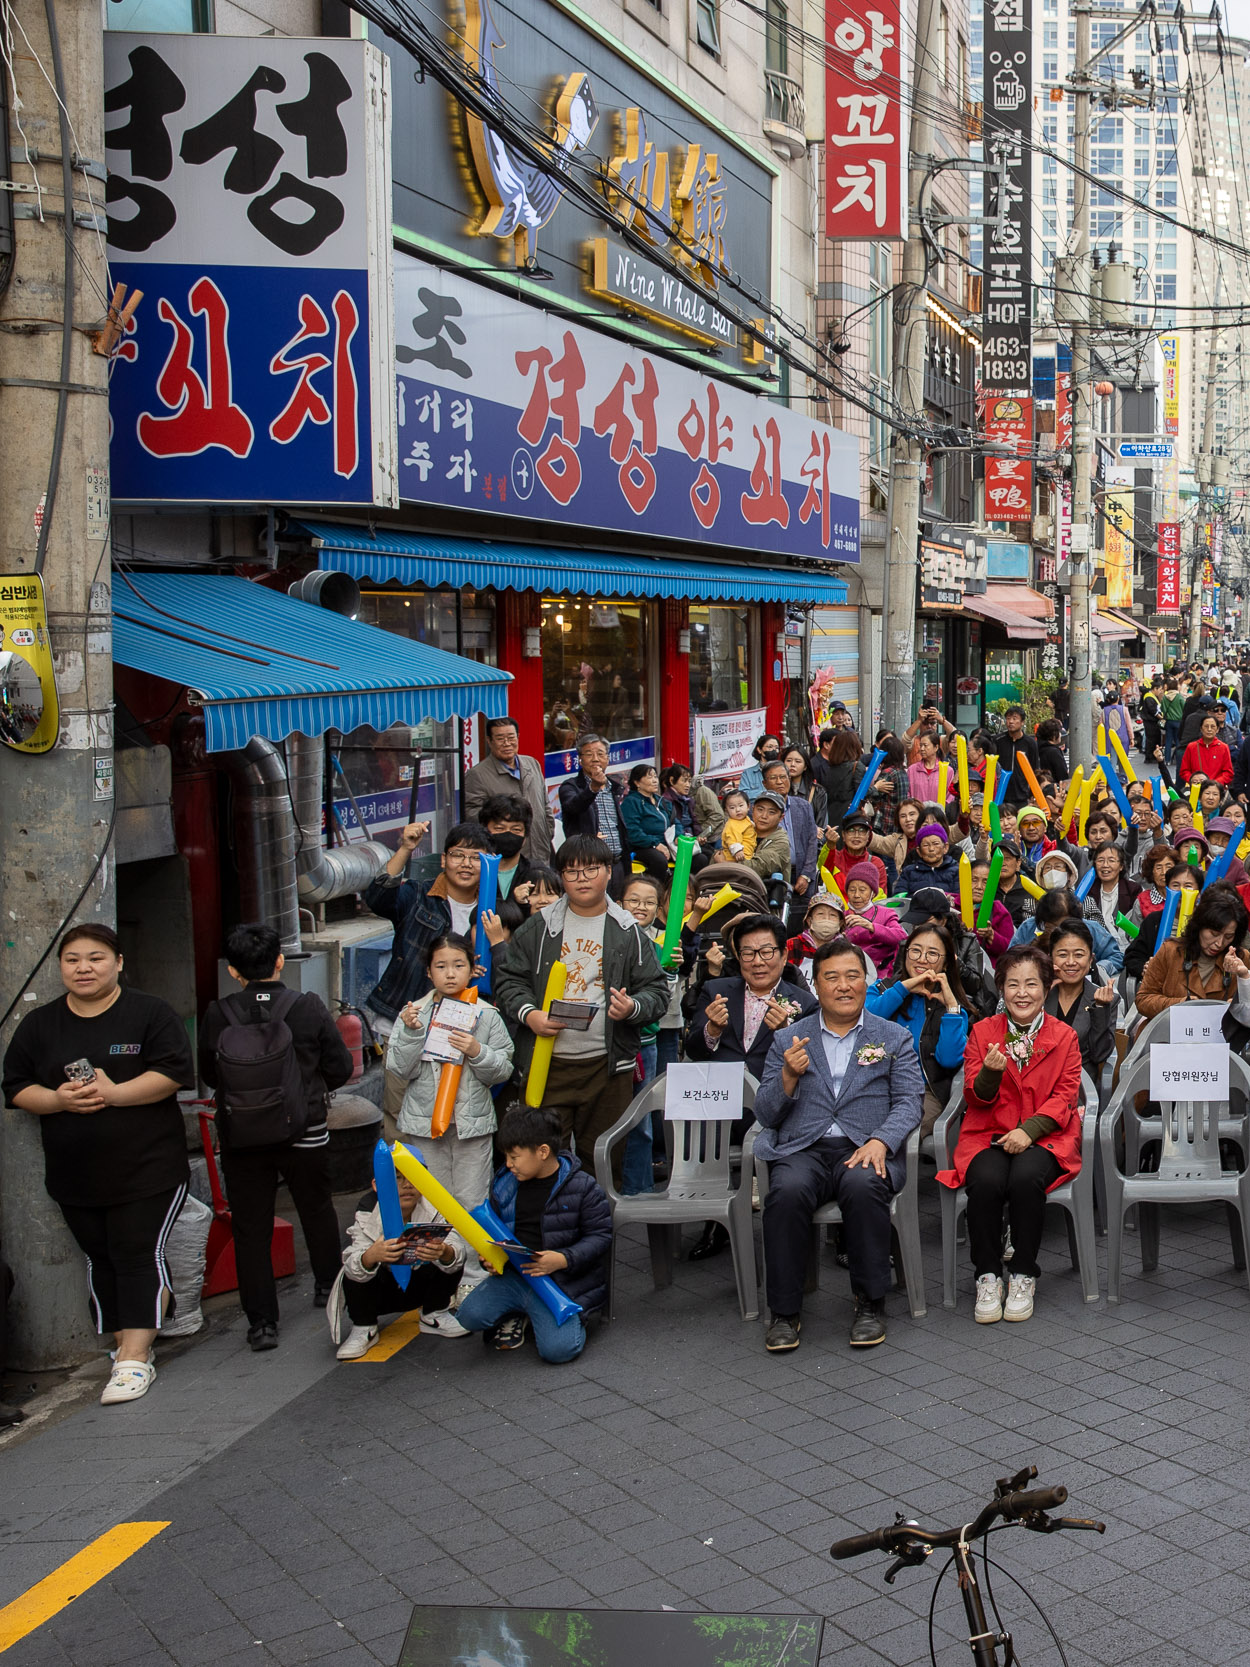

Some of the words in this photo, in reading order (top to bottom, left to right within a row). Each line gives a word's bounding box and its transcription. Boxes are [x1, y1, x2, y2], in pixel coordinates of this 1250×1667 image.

[834, 11, 895, 228] 양꼬치
[615, 254, 656, 302] Nine
[661, 275, 706, 326] Whale
[988, 304, 1026, 324] HOF
[984, 337, 1029, 356] 463-
[107, 276, 359, 478] 꼬치
[984, 361, 1028, 380] 1833
[514, 330, 832, 549] 경성양꼬치
[576, 938, 602, 956] THE
[1185, 1027, 1194, 1037] 내
[1203, 1027, 1211, 1036] 빈
[111, 1045, 139, 1053] BEAR
[1162, 1071, 1219, 1083] 당협위원장님
[682, 1090, 729, 1101] 보건소장님
